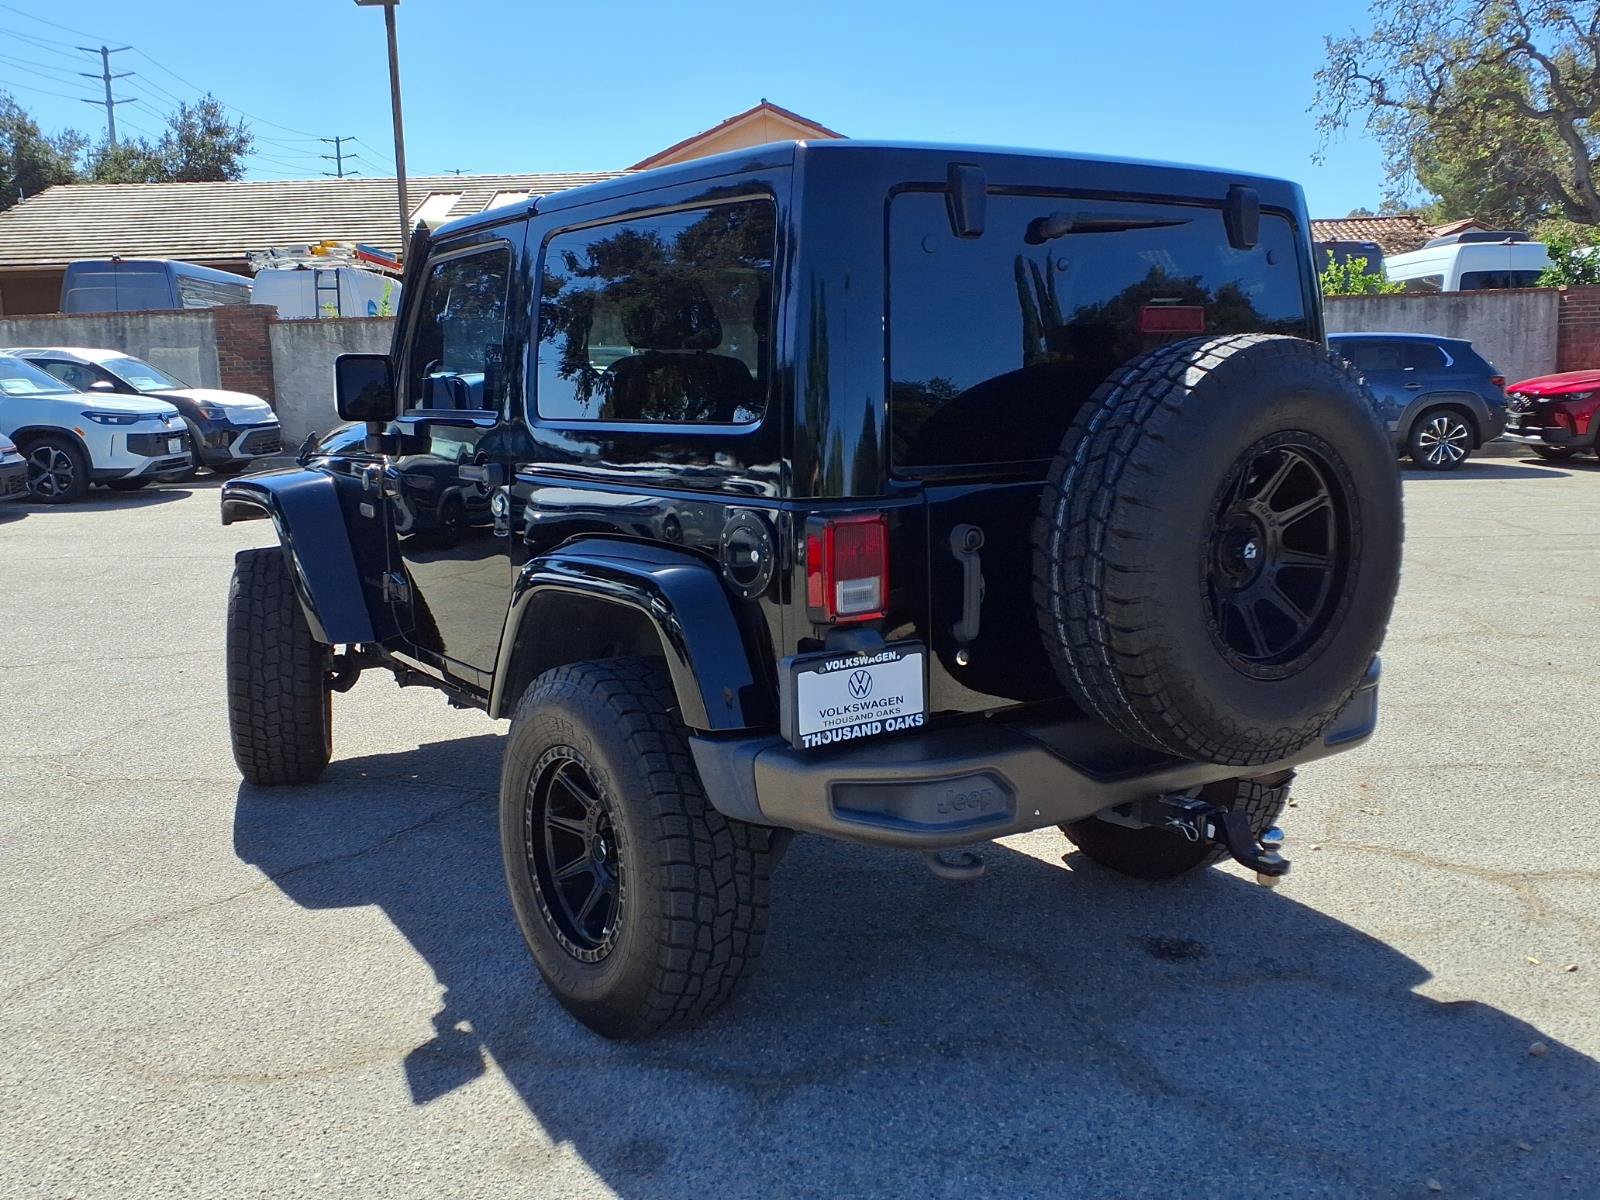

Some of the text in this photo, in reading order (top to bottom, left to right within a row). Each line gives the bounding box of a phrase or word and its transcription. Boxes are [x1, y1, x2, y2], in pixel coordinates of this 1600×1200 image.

[819, 696, 904, 718] VOLKSWAGEN
[824, 707, 901, 727] THOUSAND OAKS
[802, 713, 924, 748] THOUSAND OAKS
[936, 786, 991, 812] Jeep
